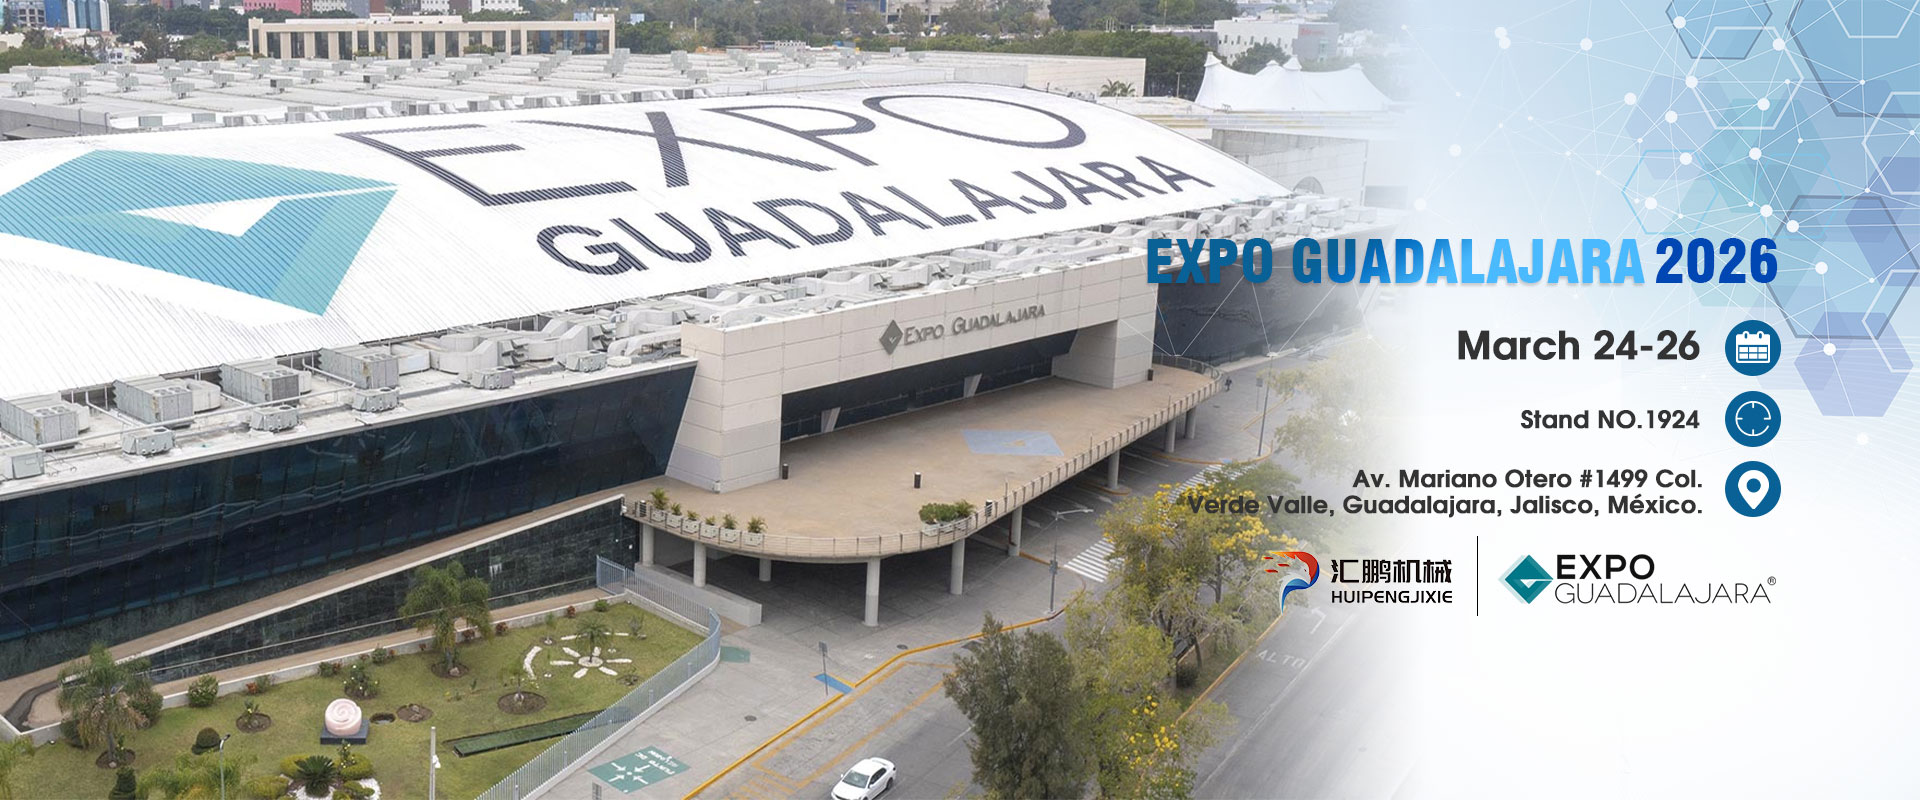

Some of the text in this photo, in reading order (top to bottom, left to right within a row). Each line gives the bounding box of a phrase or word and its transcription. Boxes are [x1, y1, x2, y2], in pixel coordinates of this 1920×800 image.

[335, 94, 1086, 207] EXPO
[537, 155, 1215, 276] GUADALAJARA
[904, 304, 1047, 346] EXPO GUADALAJARA
